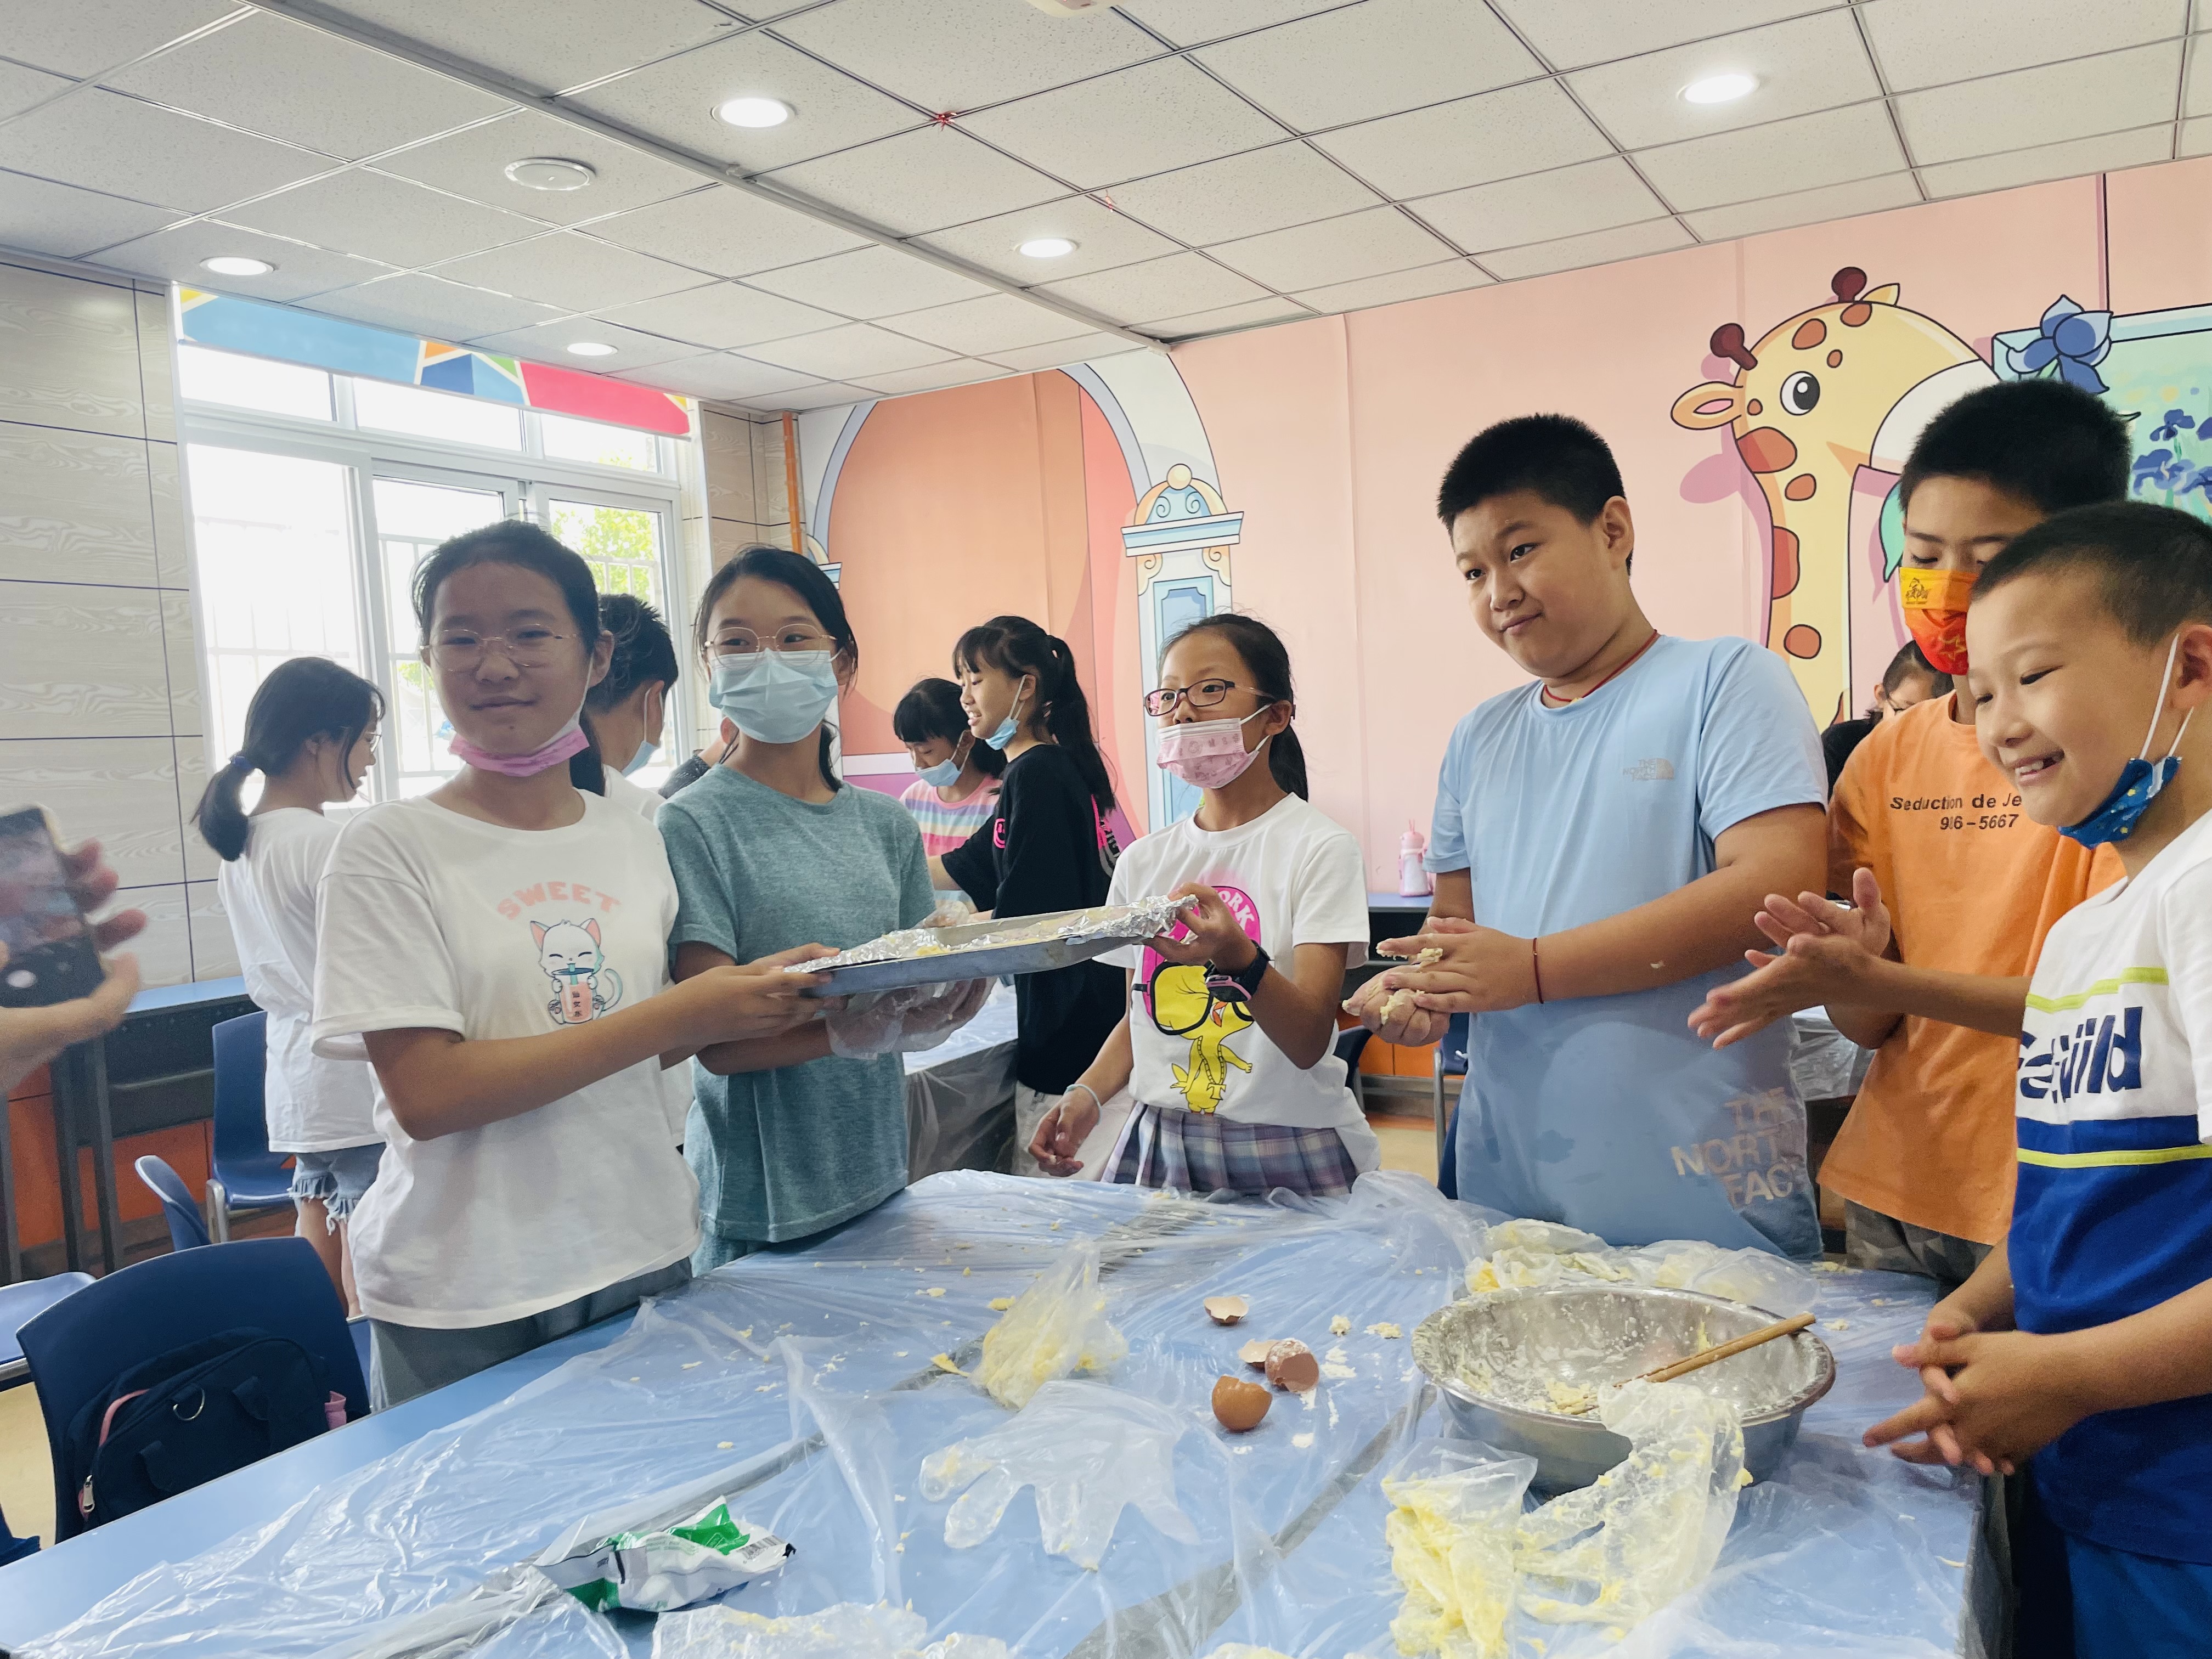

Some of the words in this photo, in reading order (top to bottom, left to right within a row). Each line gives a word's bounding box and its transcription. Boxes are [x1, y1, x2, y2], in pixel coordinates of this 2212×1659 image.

[1890, 795, 1963, 810] Seduction
[1972, 794, 1996, 808] de
[497, 881, 622, 920] SWEET
[1217, 889, 1255, 931] ORK
